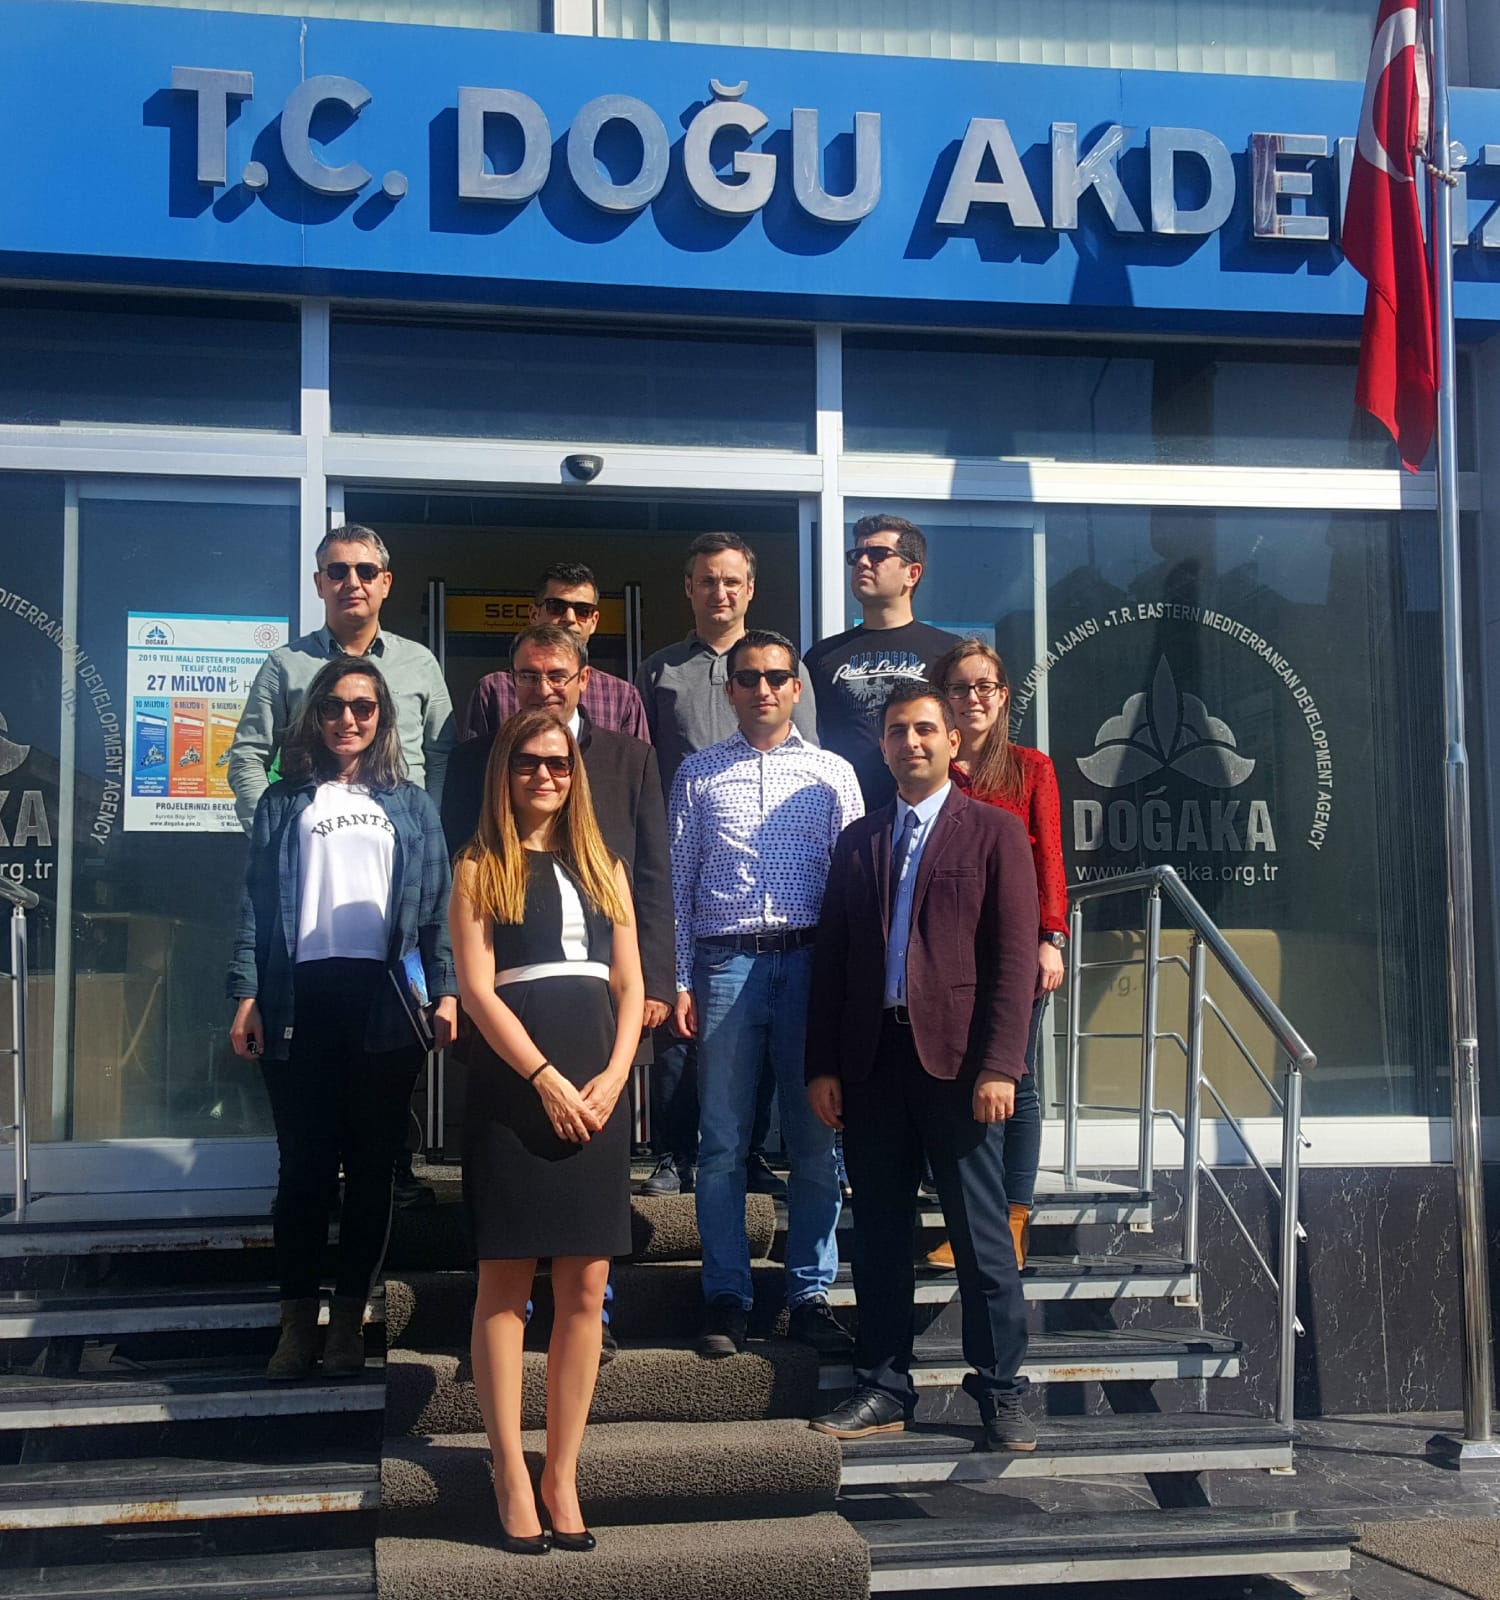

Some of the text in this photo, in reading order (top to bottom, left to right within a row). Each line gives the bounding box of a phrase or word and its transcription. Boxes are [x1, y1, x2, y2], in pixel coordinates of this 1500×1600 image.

[172, 66, 408, 200] T.C.
[457, 78, 882, 222] DOĞU
[1138, 602, 1200, 623] EASTERN
[139, 654, 157, 662] 2019
[196, 656, 223, 664] DESTEK
[869, 659, 927, 677] Label
[1202, 609, 1299, 690] MEDITERRANEAN
[147, 674, 167, 692] 27
[79, 664, 123, 776] DEVELOPMENT
[1293, 686, 1334, 788] DEVELOPMENT
[90, 779, 122, 845] AGENCY
[1308, 791, 1333, 850] AGENCY
